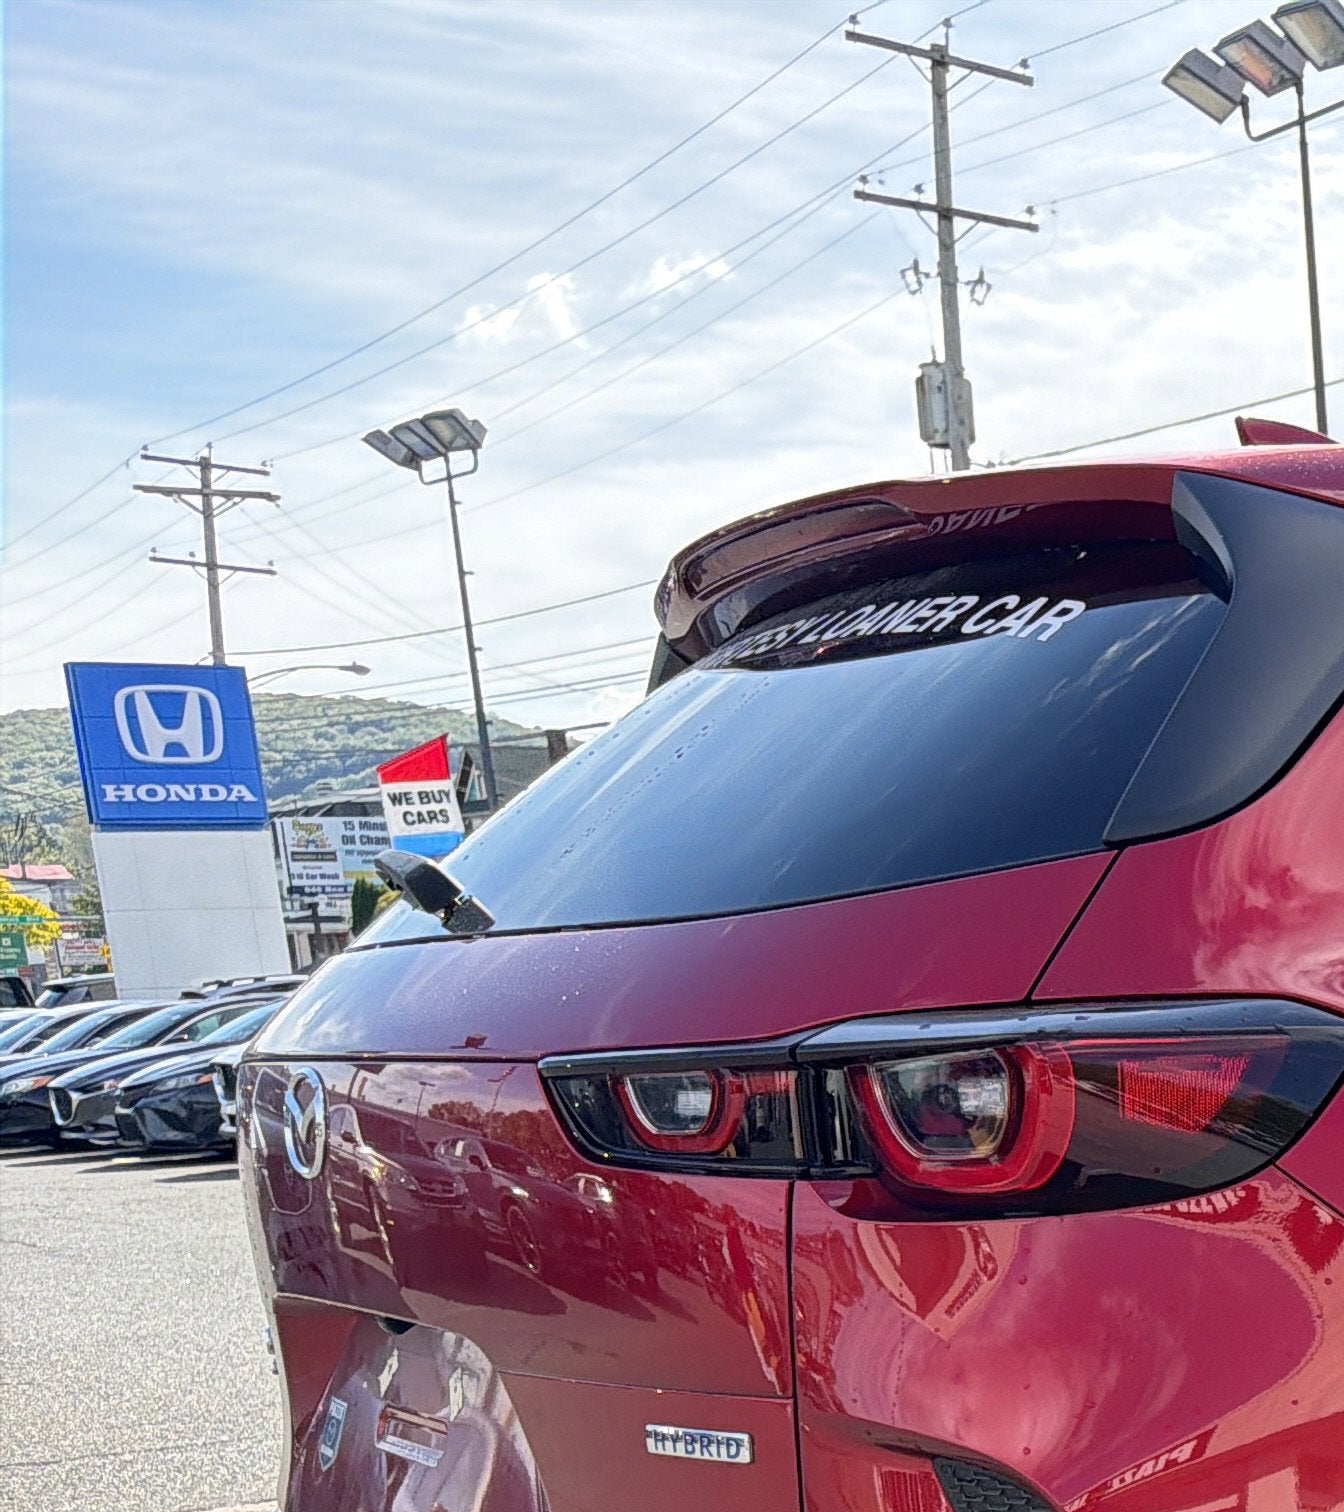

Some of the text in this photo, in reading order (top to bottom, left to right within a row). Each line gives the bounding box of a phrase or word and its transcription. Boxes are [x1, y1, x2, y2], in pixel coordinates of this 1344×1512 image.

[796, 595, 980, 644] LOANER
[960, 594, 1087, 642] CAR
[101, 783, 258, 802] HONDA
[387, 789, 452, 807] WE BUY
[402, 808, 450, 826] CARS
[652, 1429, 744, 1460] HYBRID
